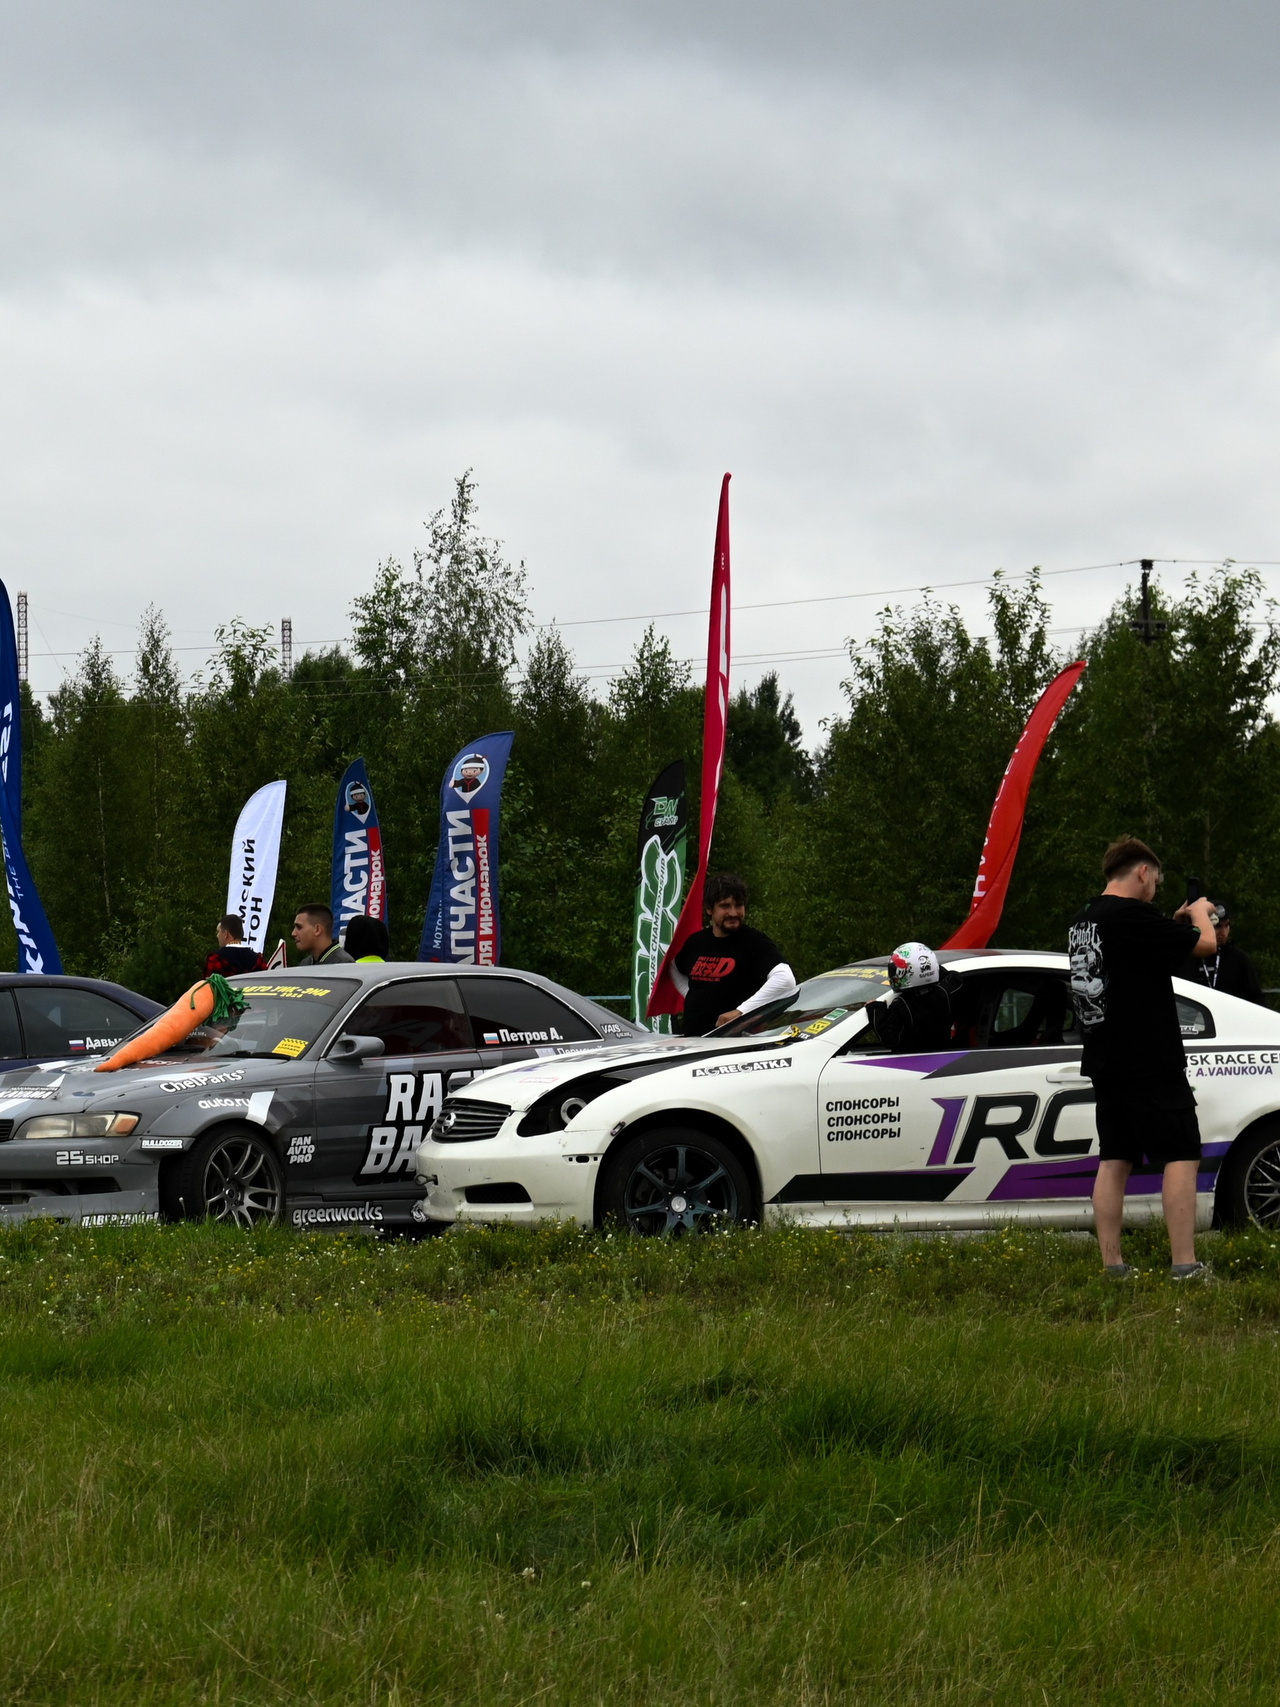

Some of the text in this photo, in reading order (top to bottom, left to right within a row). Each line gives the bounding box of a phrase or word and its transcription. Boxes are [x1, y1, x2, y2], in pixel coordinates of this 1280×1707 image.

[446, 809, 476, 965] ПЧАСТИ
[651, 857, 666, 952] CHAMPIONSHIP
[86, 1036, 122, 1050] Давы
[499, 1028, 548, 1044] Петров
[1215, 1054, 1256, 1065] RACE
[1260, 1053, 1280, 1064] CE
[694, 1058, 791, 1077] AGREGATKA
[1195, 1066, 1273, 1078] A.VANUKOVA
[159, 1071, 243, 1093] ChelParts
[197, 1097, 251, 1111] auto.ru
[825, 1096, 900, 1112] СПОНСОРЫ
[827, 1112, 901, 1128] СПОНСОРЫ
[290, 1135, 311, 1145] FAN
[827, 1127, 901, 1142] СПОНСОРЫ
[141, 1139, 183, 1147] BULLDOZER
[286, 1145, 315, 1155] AVTO
[360, 1125, 423, 1175] BA
[85, 1155, 119, 1165] SHOP
[289, 1154, 312, 1164] PRO
[292, 1202, 384, 1229] greenworks
